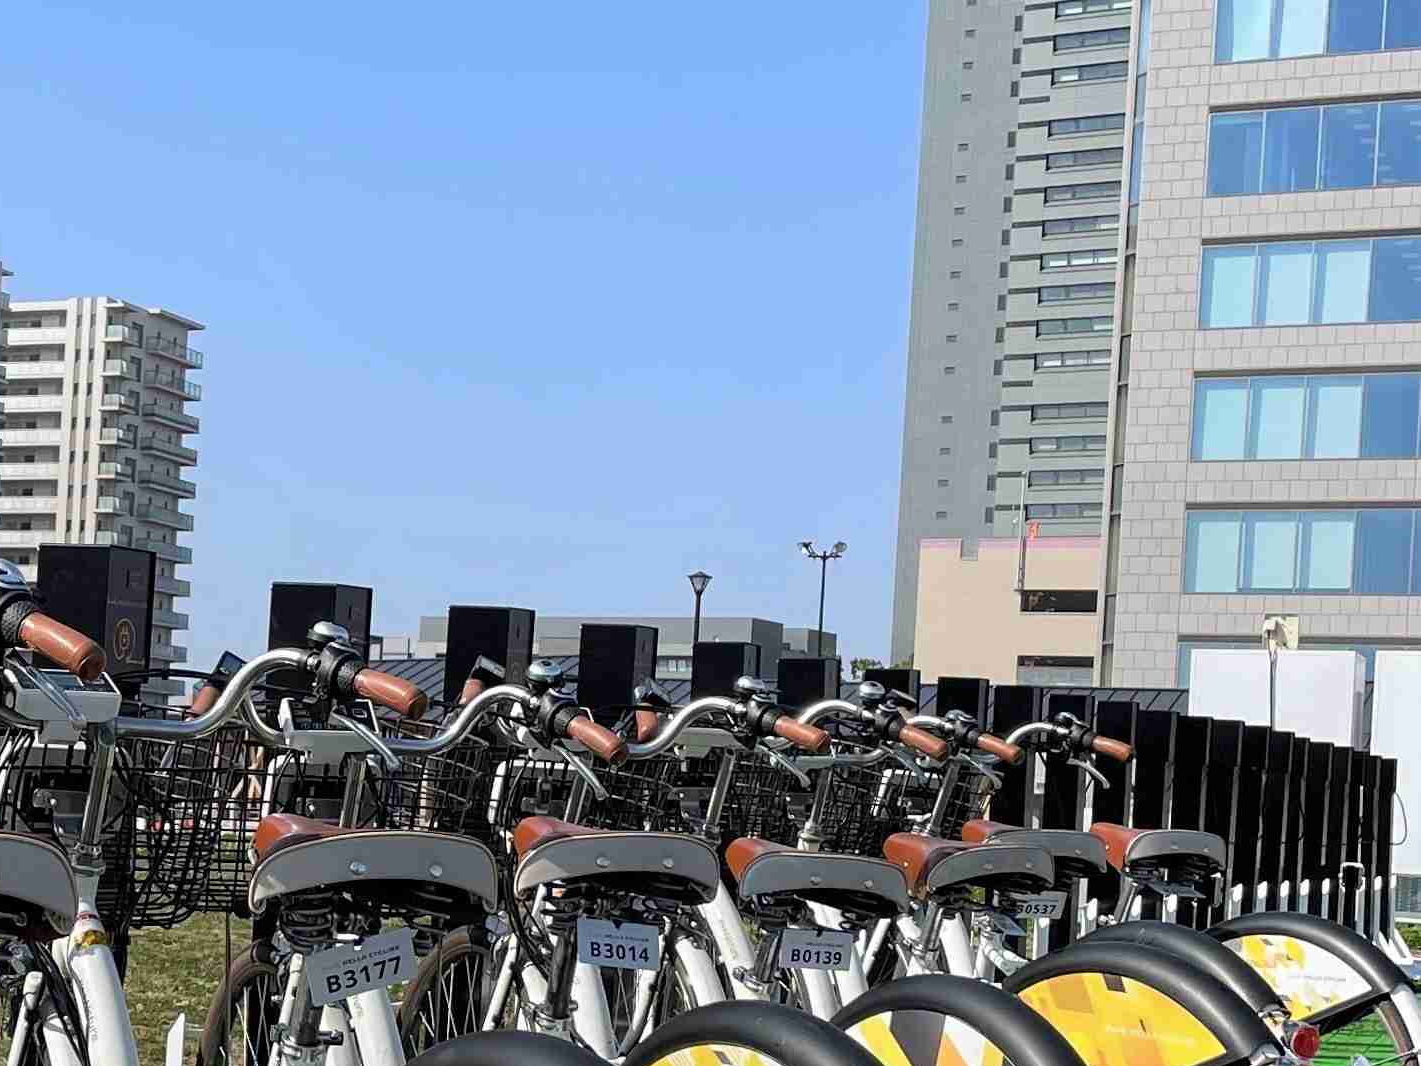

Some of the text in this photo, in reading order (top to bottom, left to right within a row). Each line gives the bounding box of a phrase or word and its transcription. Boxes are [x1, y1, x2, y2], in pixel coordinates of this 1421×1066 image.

[590, 941, 650, 962] B3014
[791, 948, 842, 965] B0139
[326, 955, 402, 994] B3177
